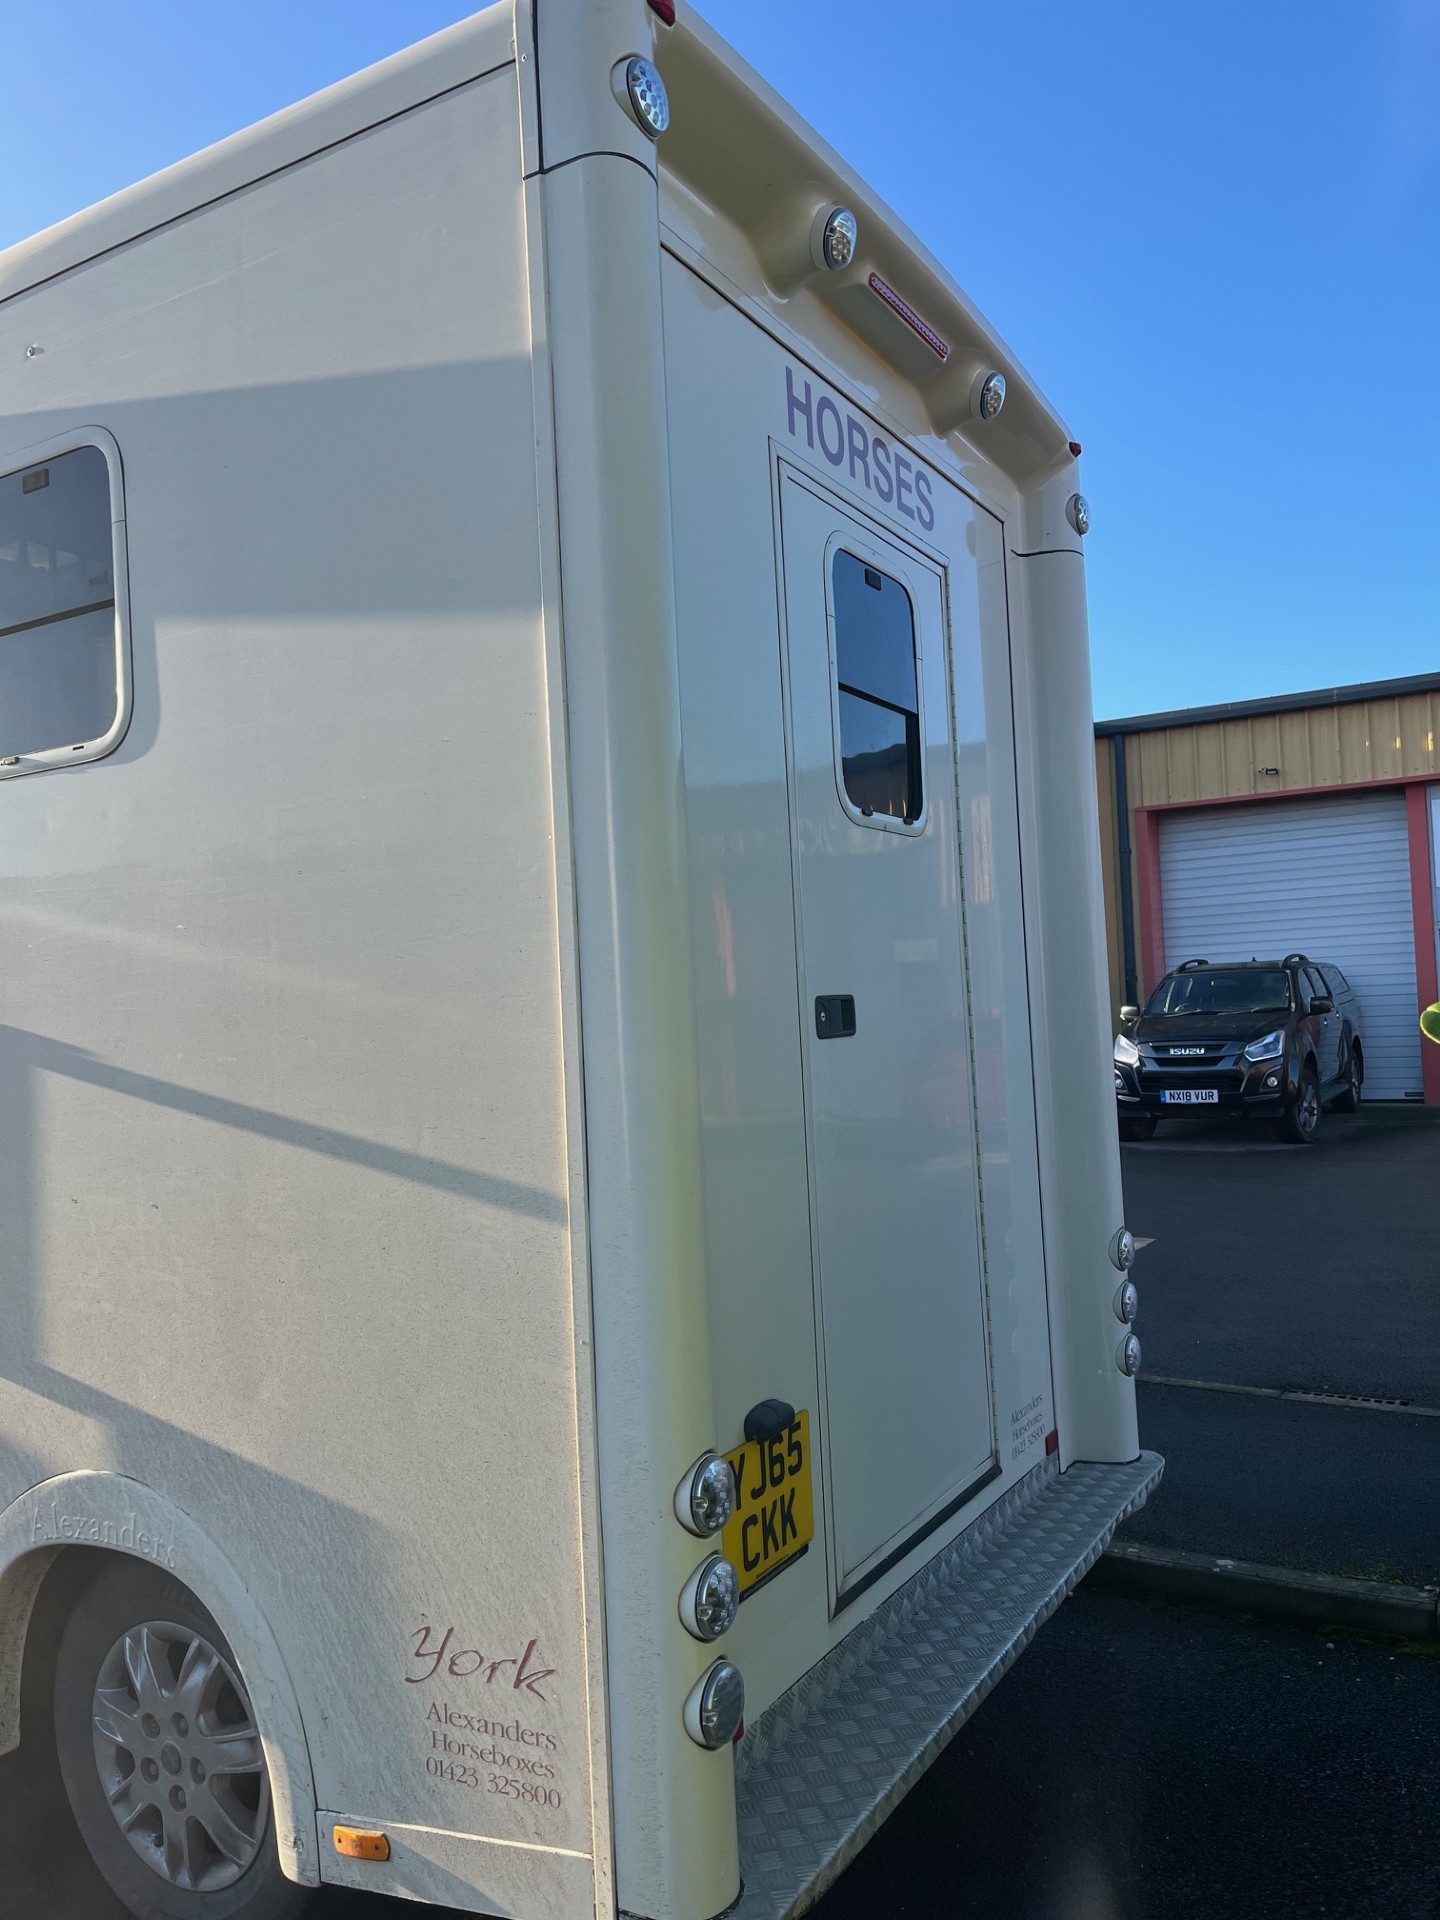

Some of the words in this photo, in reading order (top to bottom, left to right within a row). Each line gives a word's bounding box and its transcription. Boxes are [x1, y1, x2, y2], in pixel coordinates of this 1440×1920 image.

[785, 365, 935, 532] HORSES
[1169, 1047, 1205, 1055] ISUZU
[1168, 1091, 1192, 1101] NX18
[1193, 1091, 1215, 1101] VUR
[727, 1421, 803, 1511] YJ65
[31, 1501, 176, 1568] Alexanders
[741, 1487, 798, 1573] CKK
[404, 1626, 557, 1702] York
[425, 1702, 557, 1750] Alexanders
[431, 1730, 555, 1779] Horseboxes
[425, 1756, 479, 1788] 01423
[486, 1772, 561, 1809] 325800
